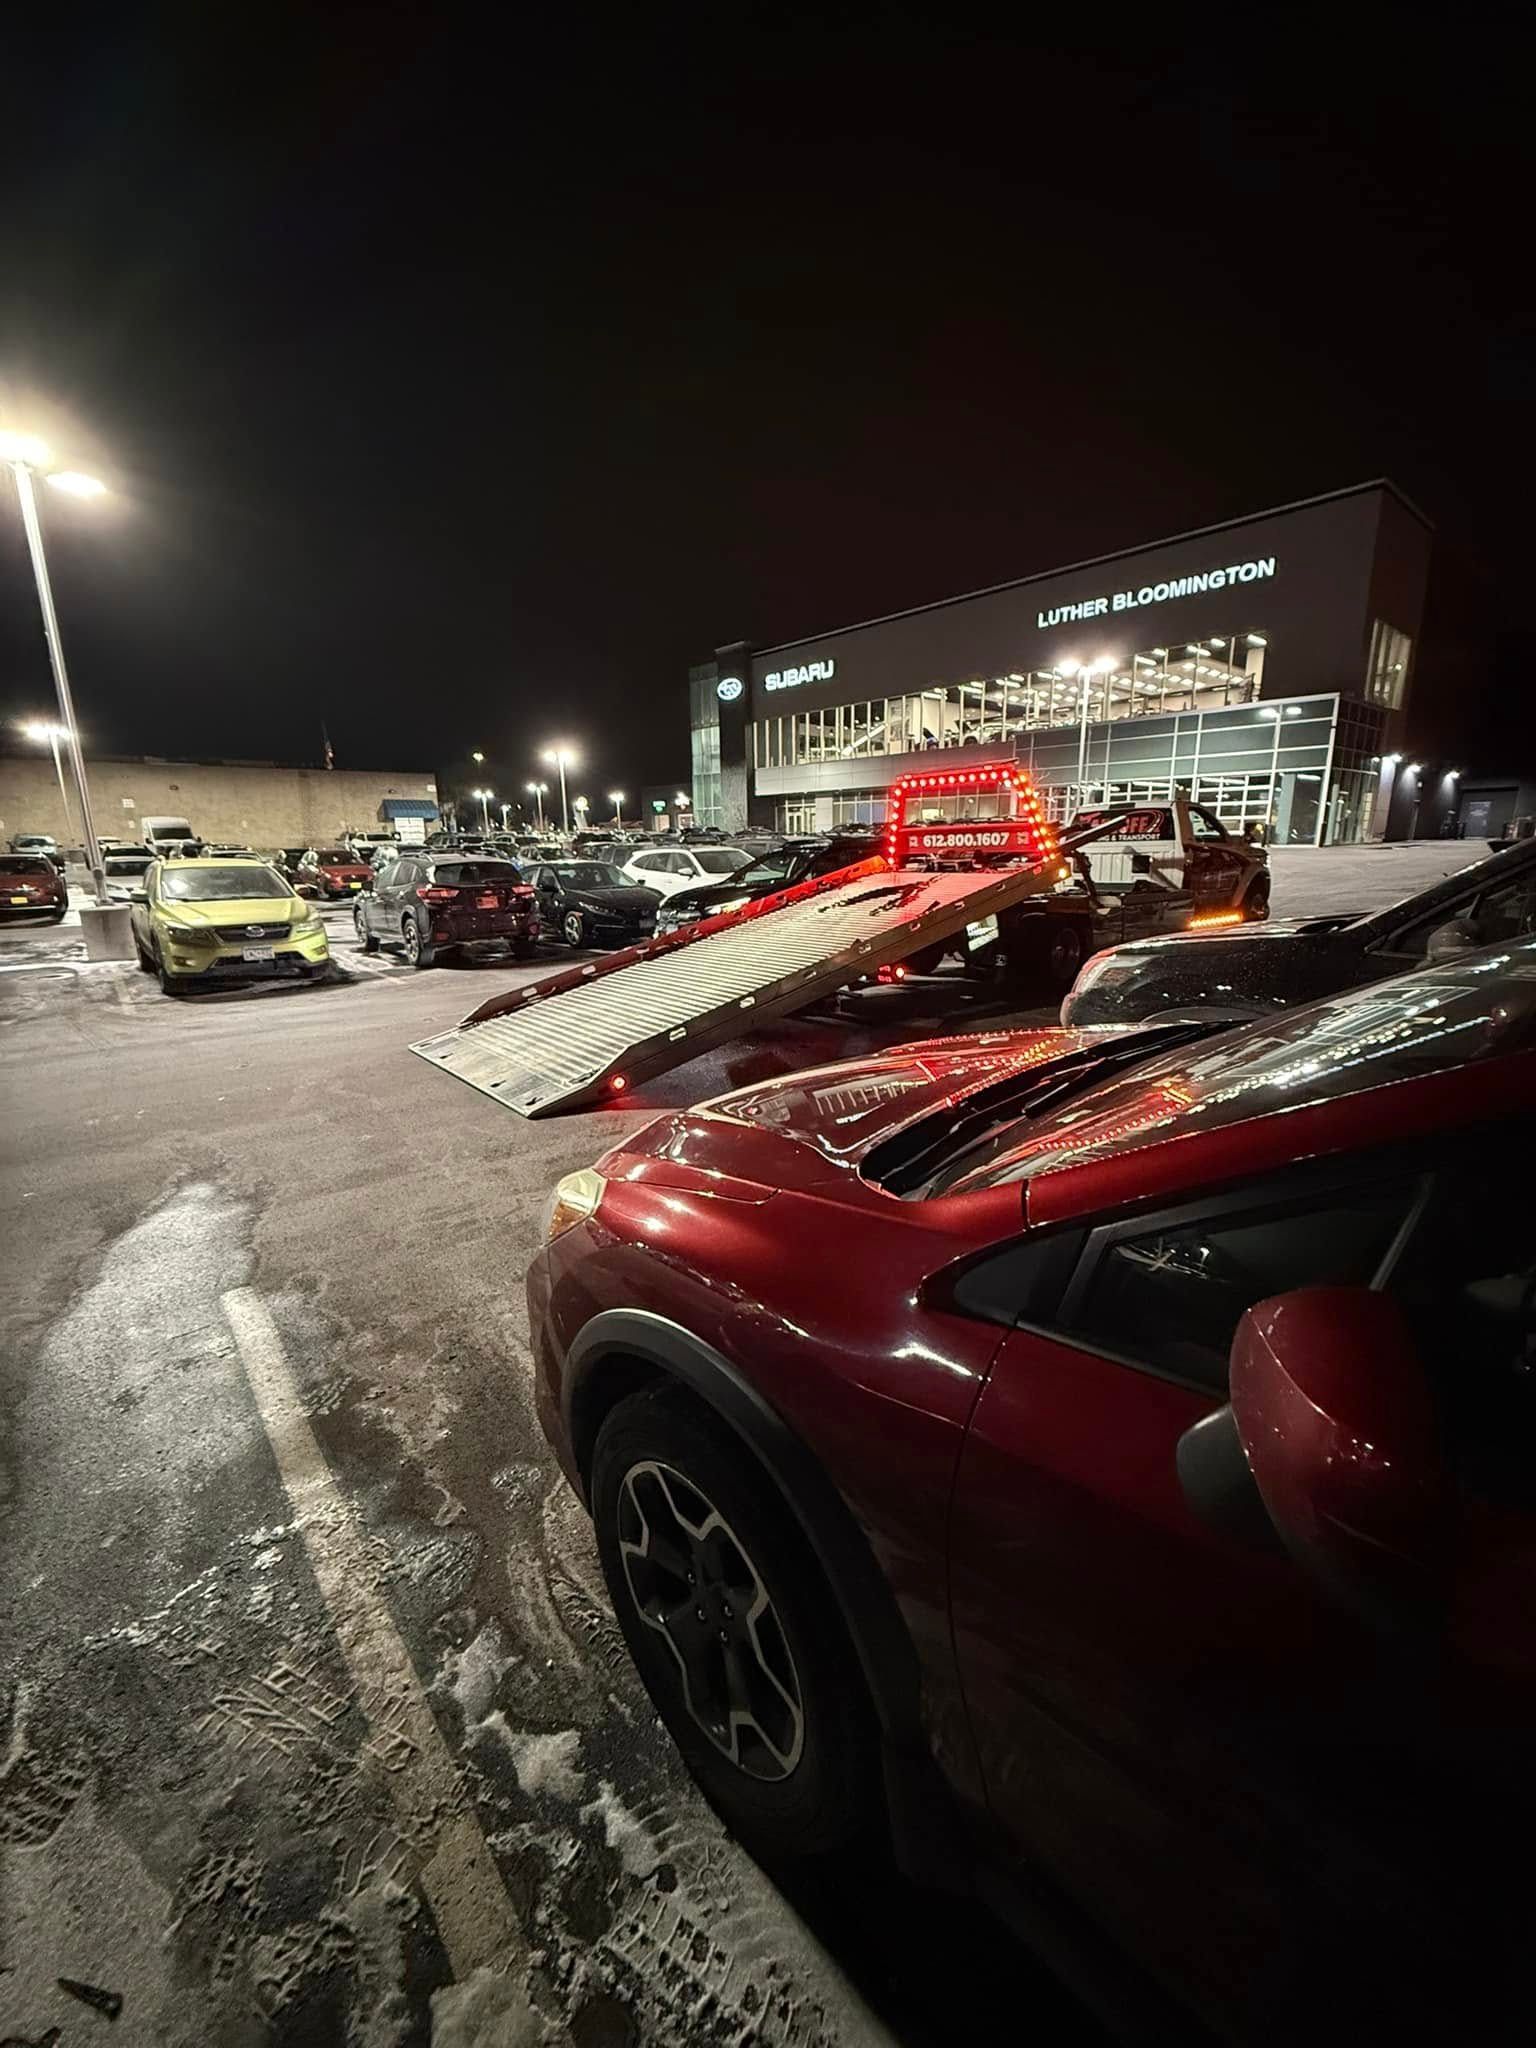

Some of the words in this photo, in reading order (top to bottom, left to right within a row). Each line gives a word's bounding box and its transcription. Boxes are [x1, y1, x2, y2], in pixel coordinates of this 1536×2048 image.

[1037, 597, 1109, 629] LUTHER
[1112, 557, 1276, 612] BLOOMINGTON
[765, 659, 835, 691] SUBARU
[922, 832, 1010, 848] 612.800.1607
[1119, 833, 1161, 841] TRANSPORT
